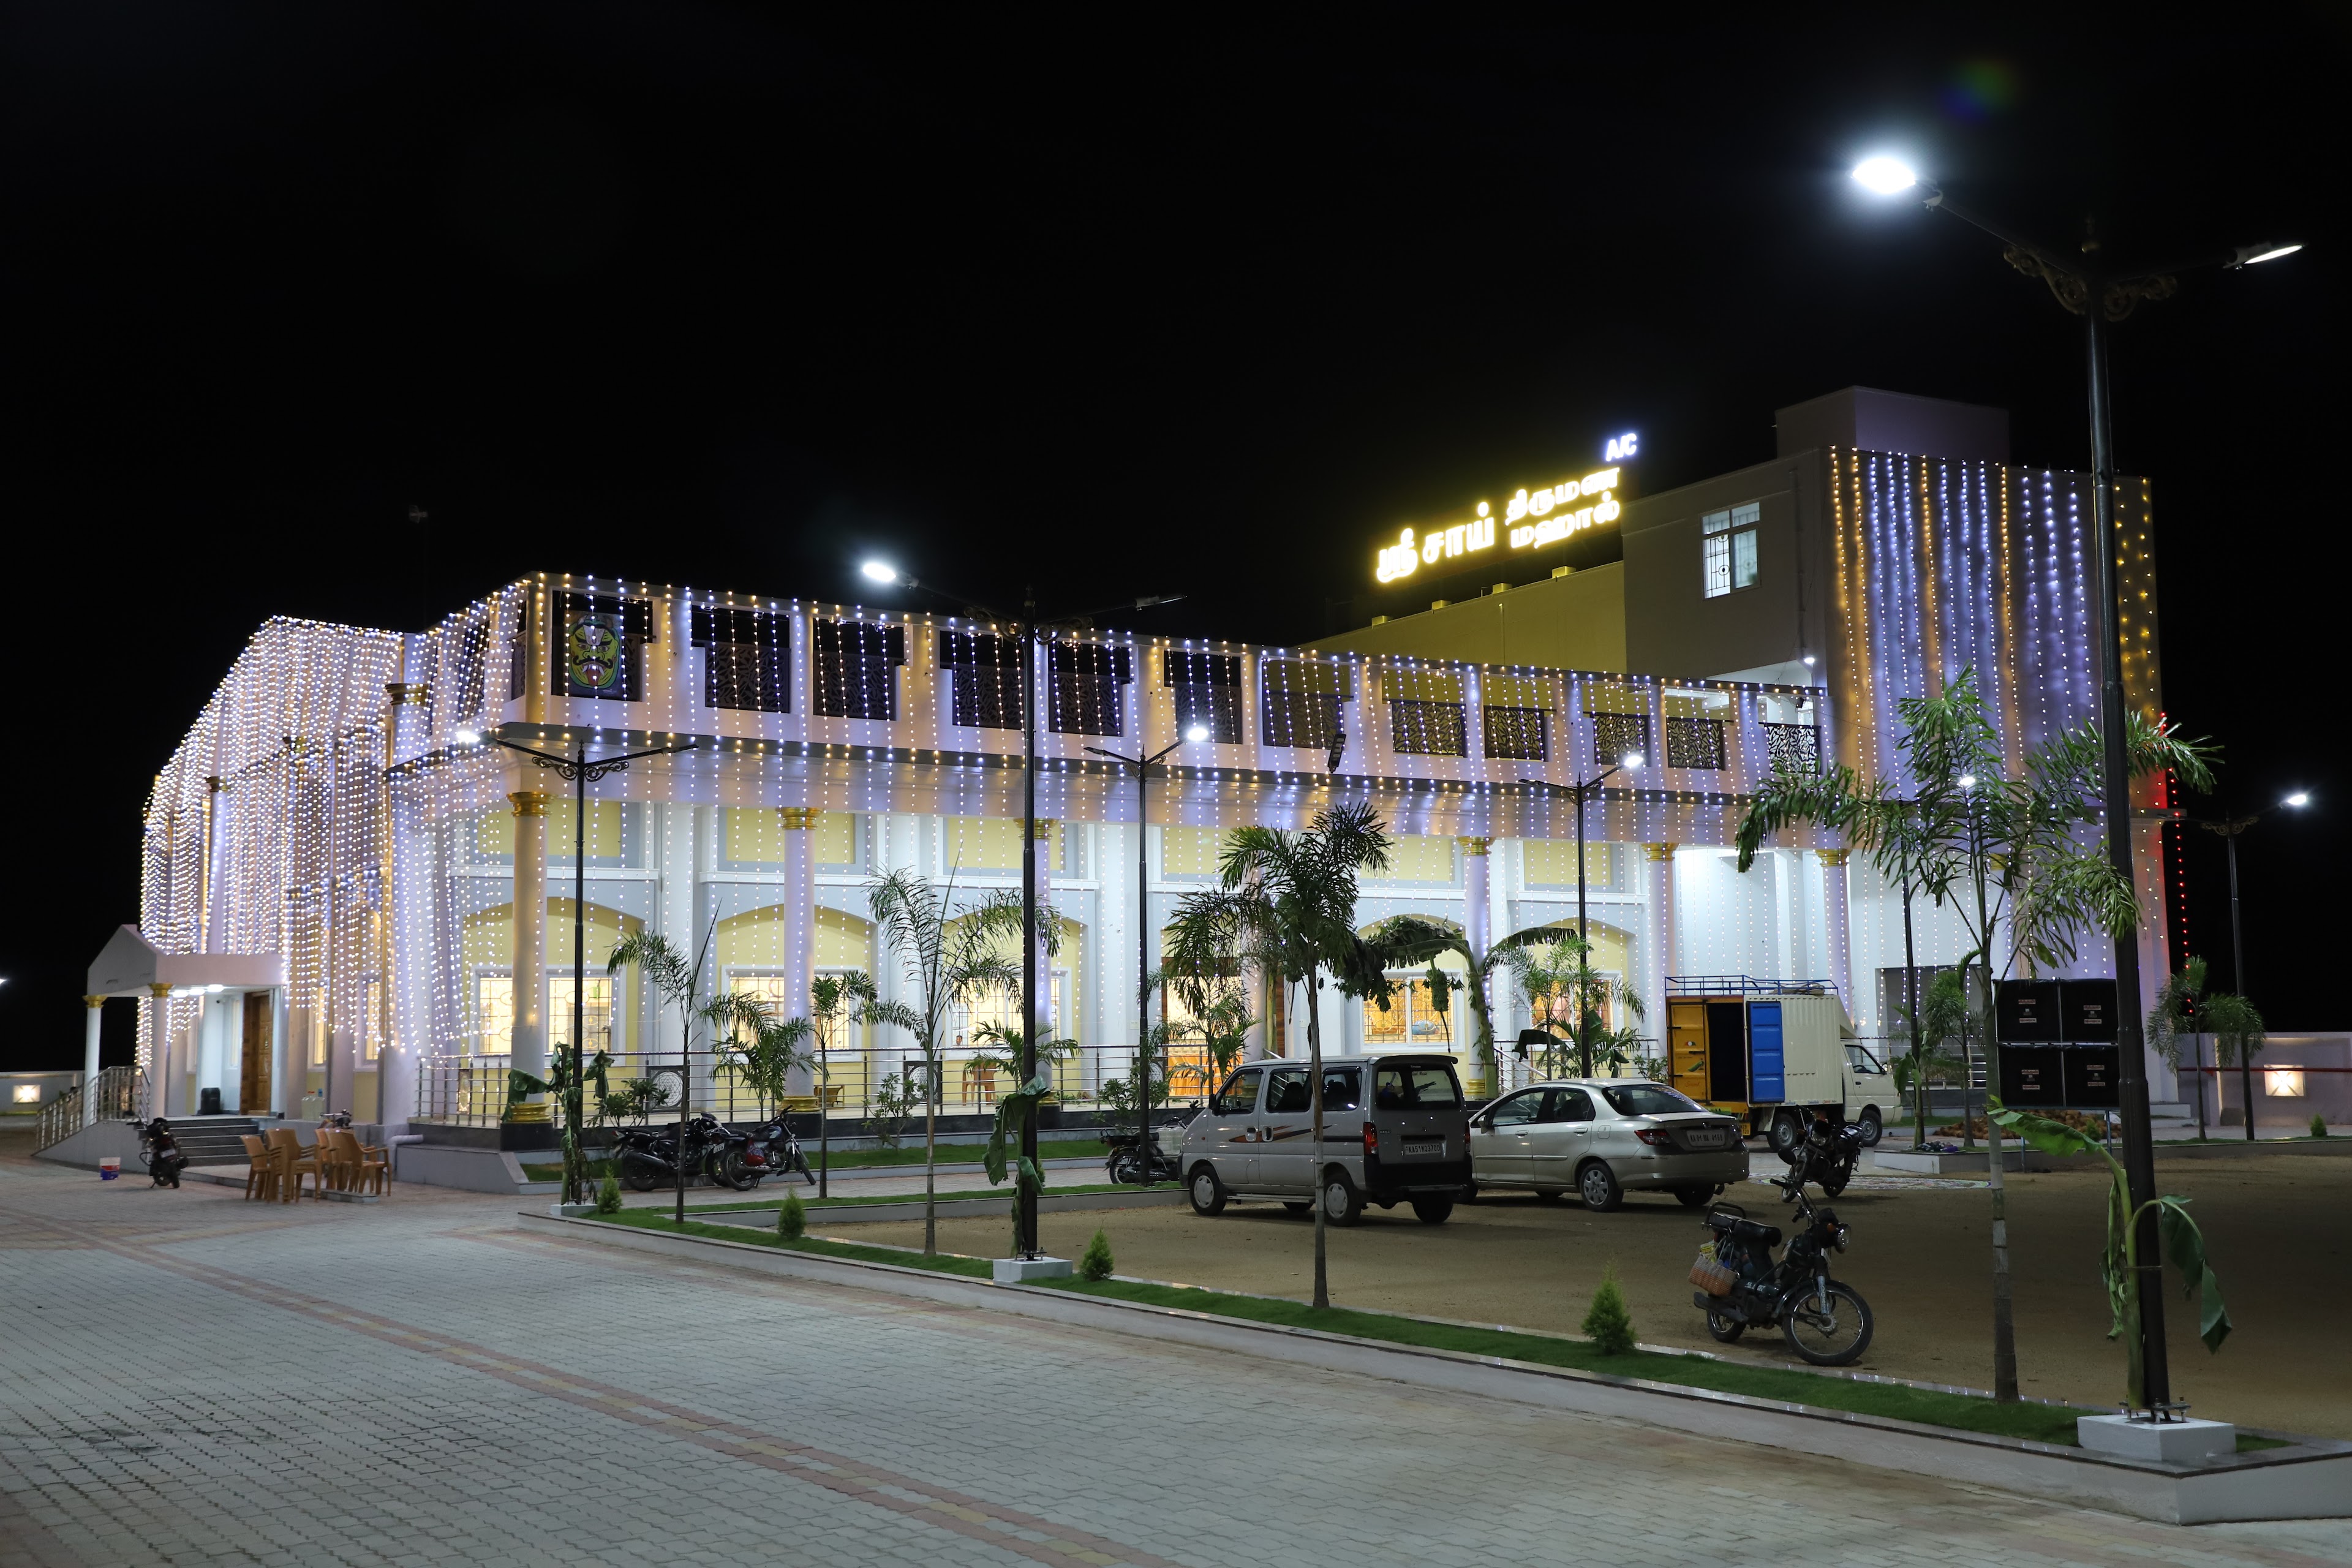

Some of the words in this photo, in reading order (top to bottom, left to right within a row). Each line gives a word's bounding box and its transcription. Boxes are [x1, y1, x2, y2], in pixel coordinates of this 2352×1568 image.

[1606, 433, 1637, 462] A/C
[1506, 467, 1621, 526] திருமண
[1510, 491, 1621, 549] மஹால்
[1422, 501, 1495, 564] சாய்
